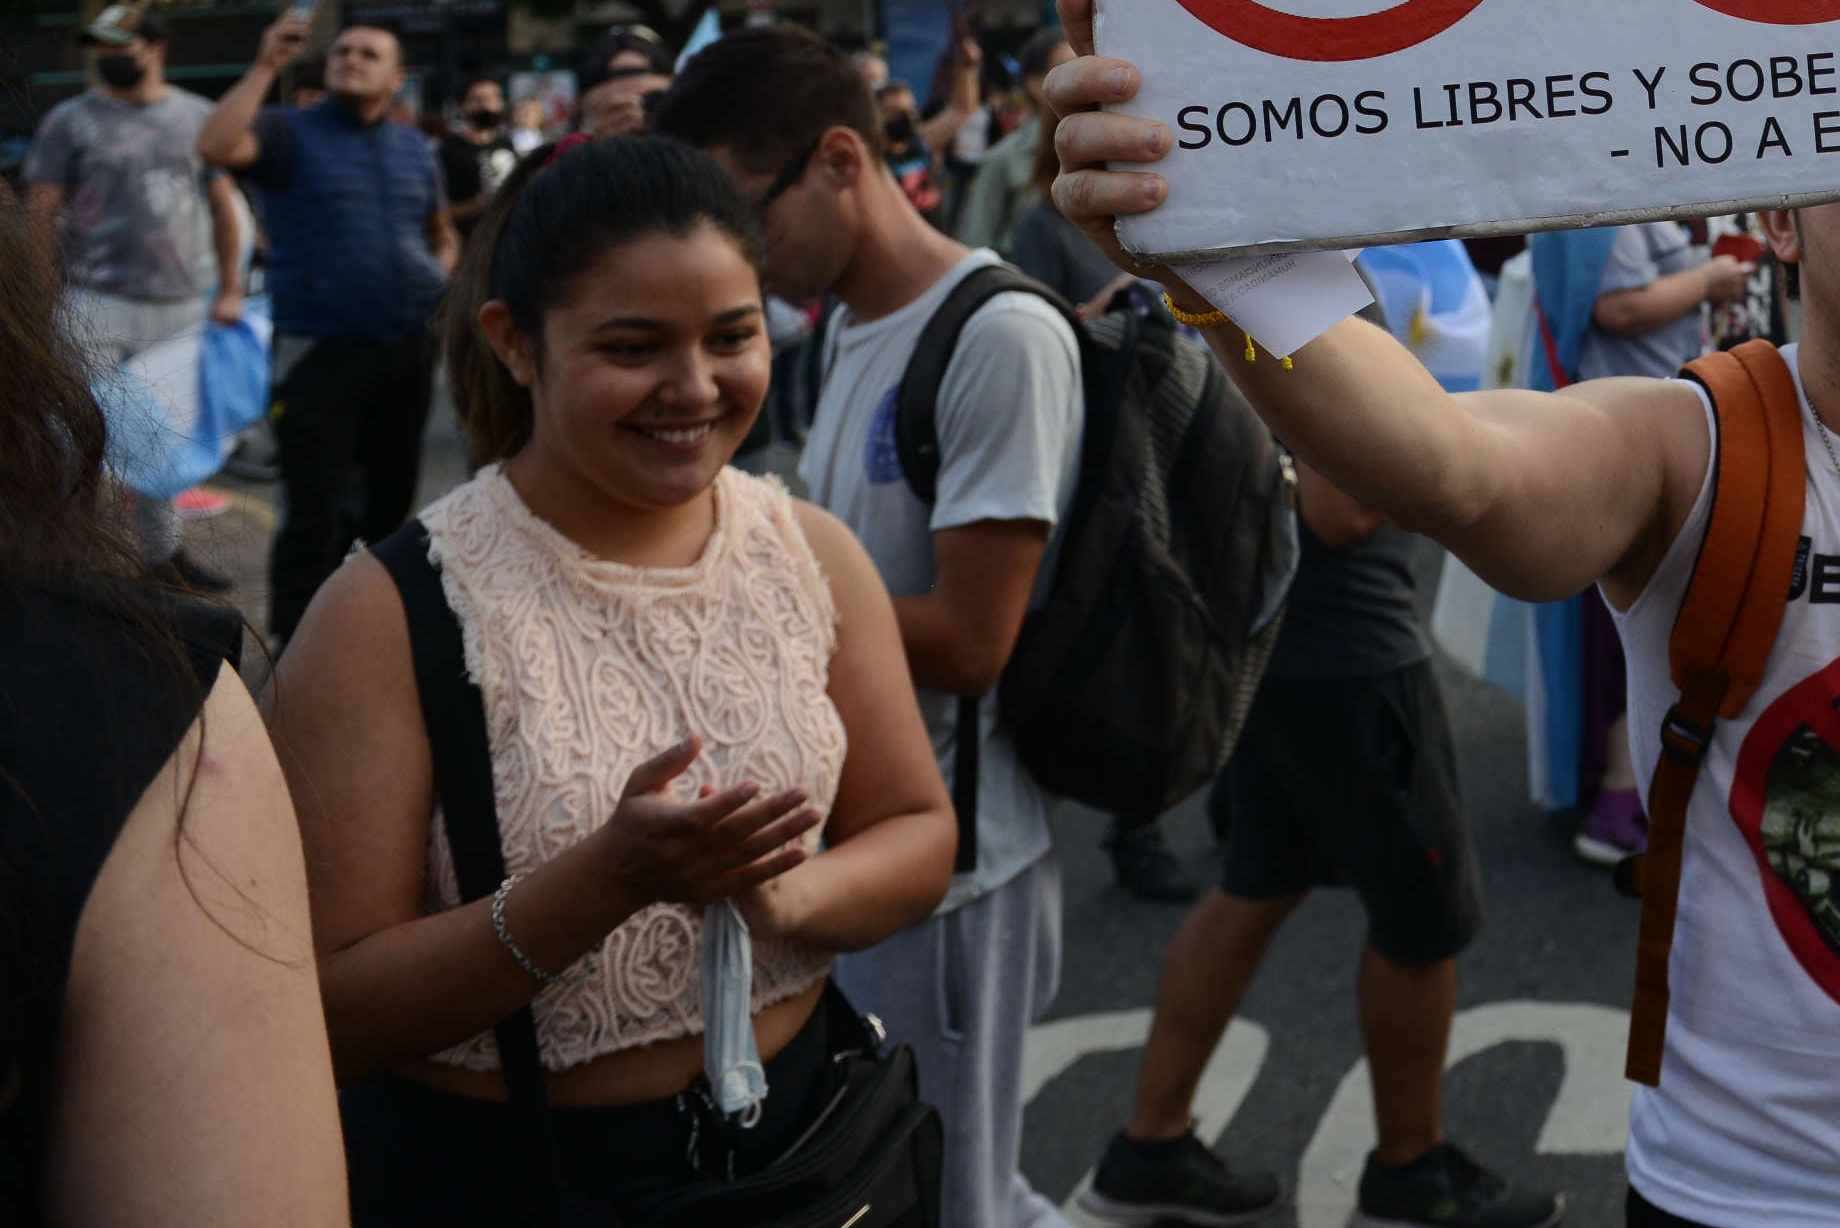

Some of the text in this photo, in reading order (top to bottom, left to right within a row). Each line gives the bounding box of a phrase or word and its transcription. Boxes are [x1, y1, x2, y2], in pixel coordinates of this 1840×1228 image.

[1177, 91, 1388, 149] SOMOS
[1414, 72, 1612, 129] LIBRES
[1633, 67, 1665, 109] Y
[1655, 121, 1732, 167] NO
[1757, 117, 1792, 158] A
